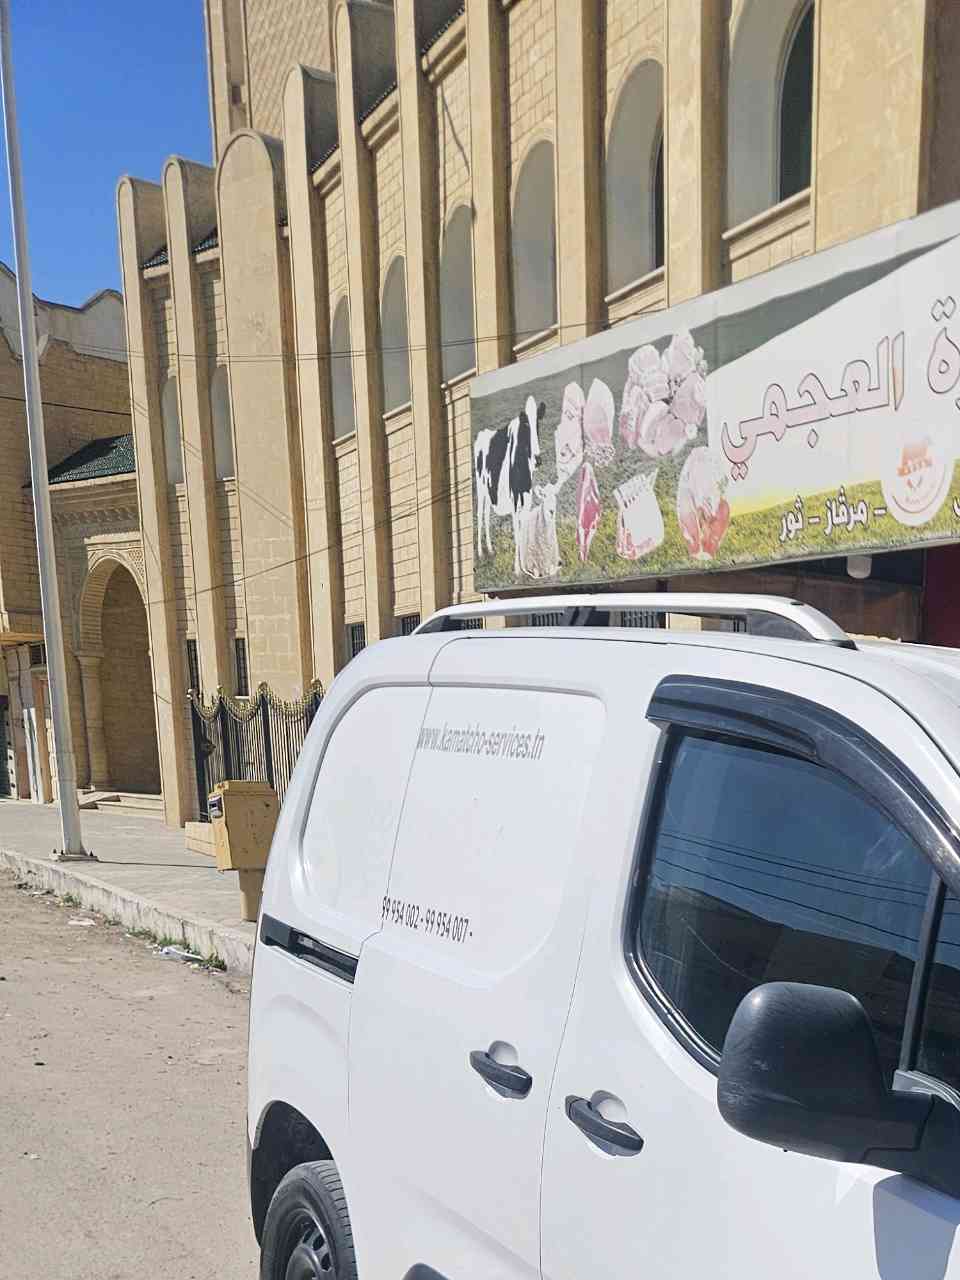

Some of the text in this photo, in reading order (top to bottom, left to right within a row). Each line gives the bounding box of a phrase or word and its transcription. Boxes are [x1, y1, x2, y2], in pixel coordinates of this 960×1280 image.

[720, 331, 905, 482] العجمي
[391, 900, 405, 924] 954
[405, 904, 419, 929] 002
[425, 908, 435, 934] 99
[436, 911, 451, 937] 954
[452, 915, 469, 943] 007
